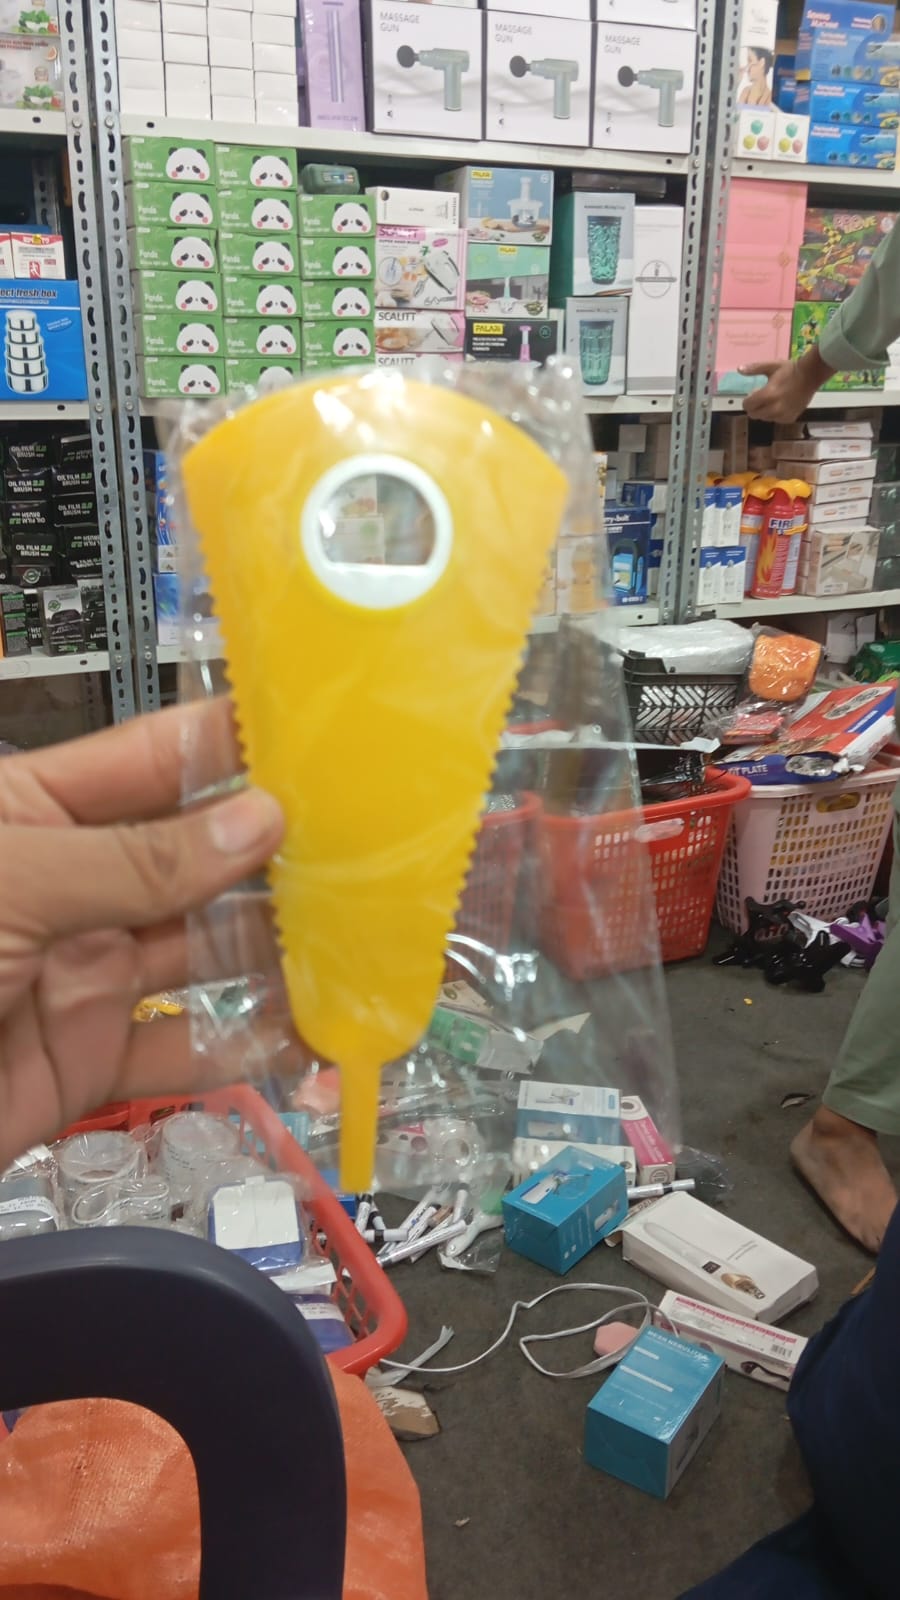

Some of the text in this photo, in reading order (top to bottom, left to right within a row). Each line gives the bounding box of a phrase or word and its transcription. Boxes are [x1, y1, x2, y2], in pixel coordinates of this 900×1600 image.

[380, 12, 420, 24] MASSAGE
[380, 22, 400, 32] GUN
[495, 24, 532, 34] MASSAGE
[495, 34, 512, 43] GUN
[605, 35, 640, 46] MASSAGE
[604, 45, 622, 54] GUN
[16, 288, 39, 298] fresh
[41, 289, 57, 298] box
[378, 312, 416, 321] SCALITT
[742, 764, 768, 774] PLATE
